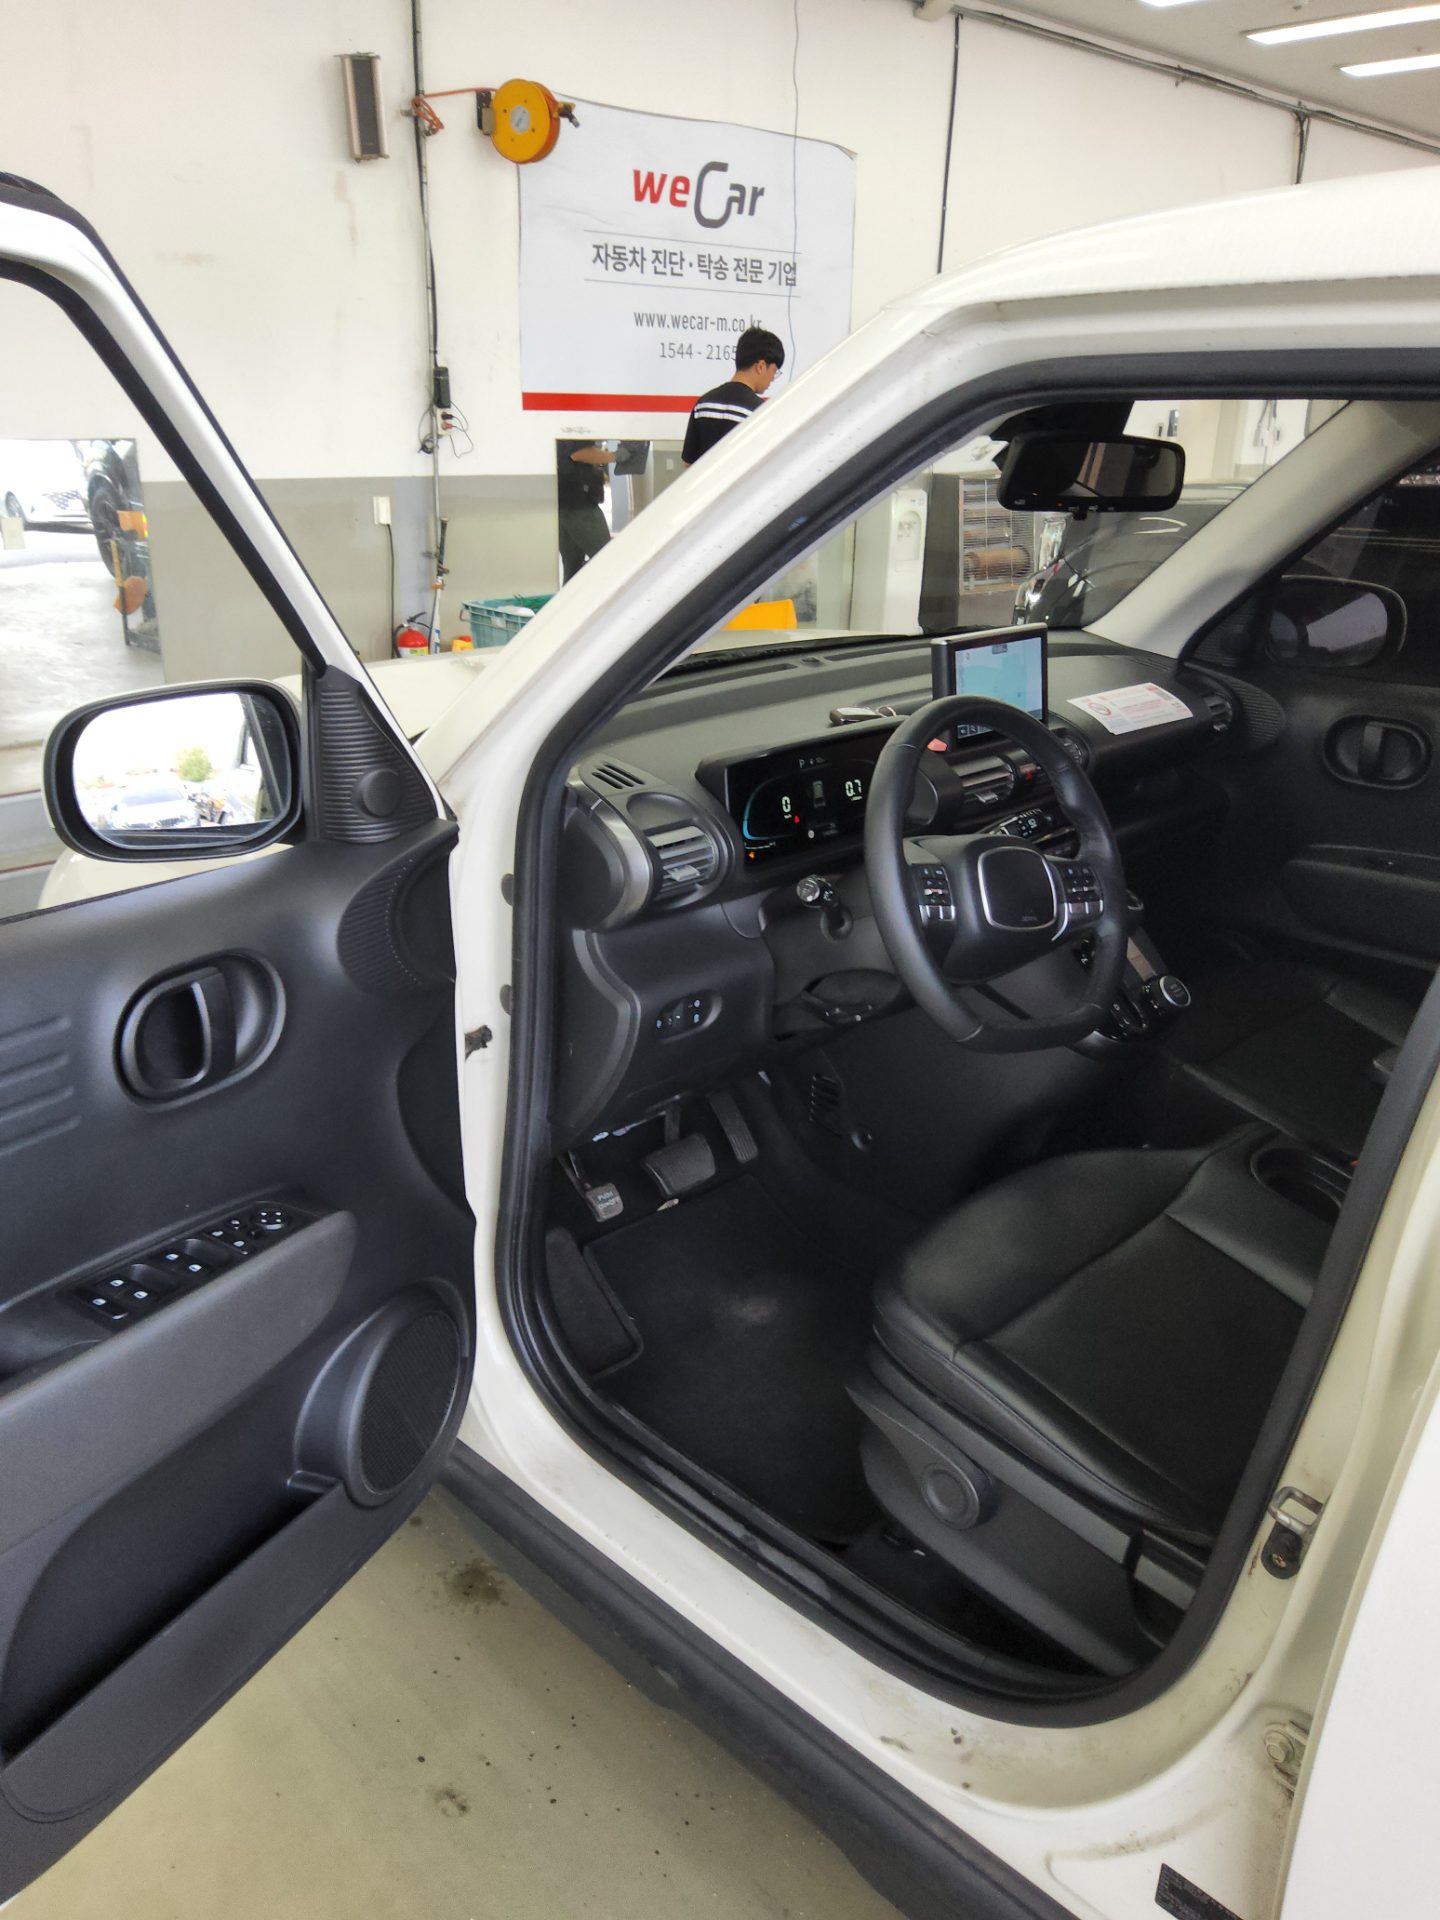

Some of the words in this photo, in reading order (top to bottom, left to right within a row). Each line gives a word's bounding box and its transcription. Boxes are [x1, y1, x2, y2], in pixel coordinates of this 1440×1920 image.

[592, 243, 647, 274] 자동차
[733, 257, 764, 284] 전문
[768, 260, 797, 287] 기업
[633, 312, 762, 333] www.wecar-m.cokr
